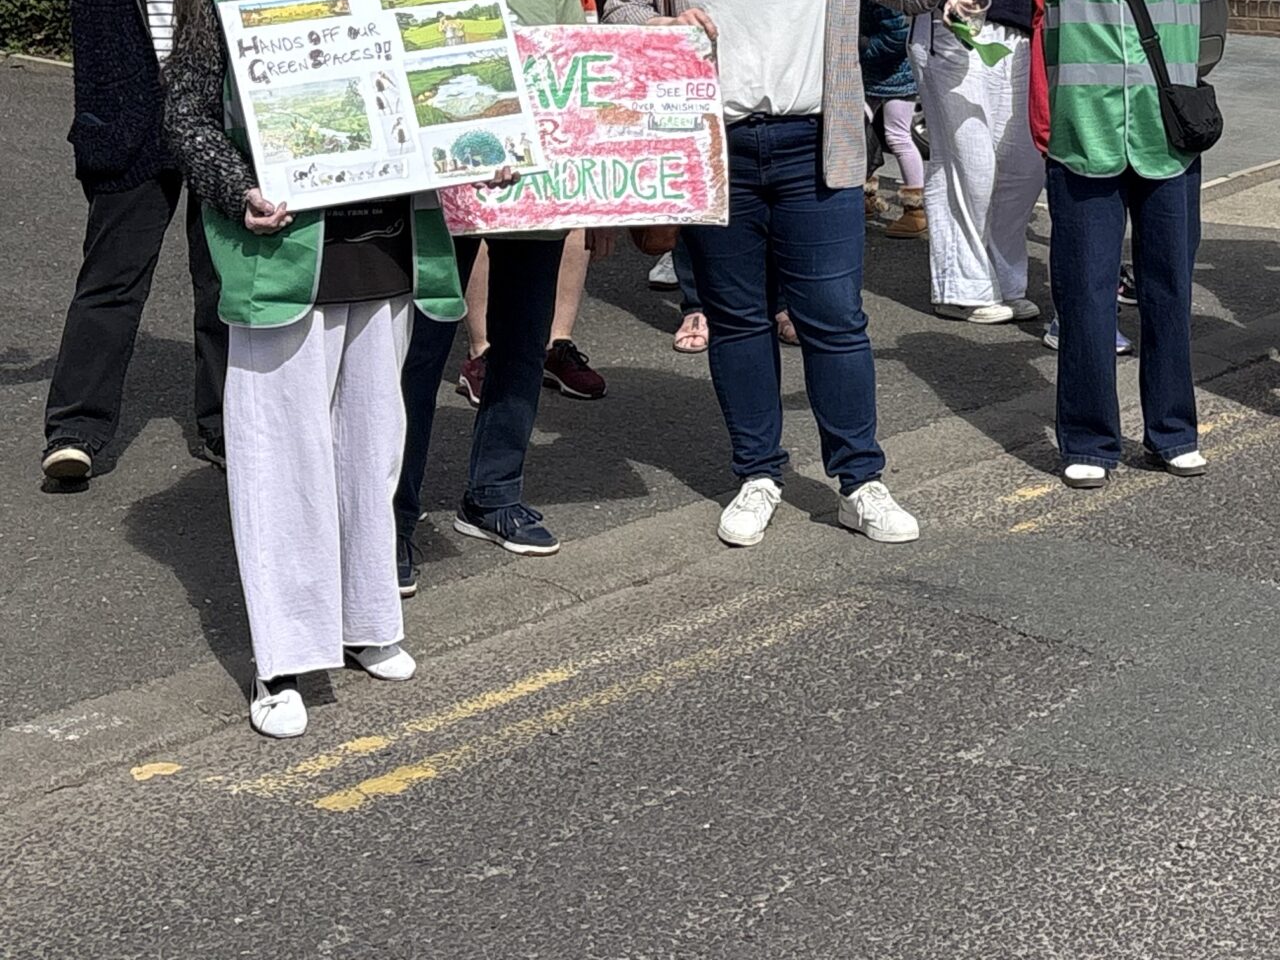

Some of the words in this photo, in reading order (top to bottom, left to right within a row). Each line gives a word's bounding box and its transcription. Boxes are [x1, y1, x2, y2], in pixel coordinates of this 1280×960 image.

[237, 35, 304, 58] HANDS
[308, 26, 340, 45] OFF
[347, 22, 381, 40] OUR
[248, 58, 309, 84] GREEN
[523, 54, 617, 110] AVE
[656, 83, 682, 98] SEE
[685, 82, 716, 99] RED
[662, 103, 710, 112] VANISHING
